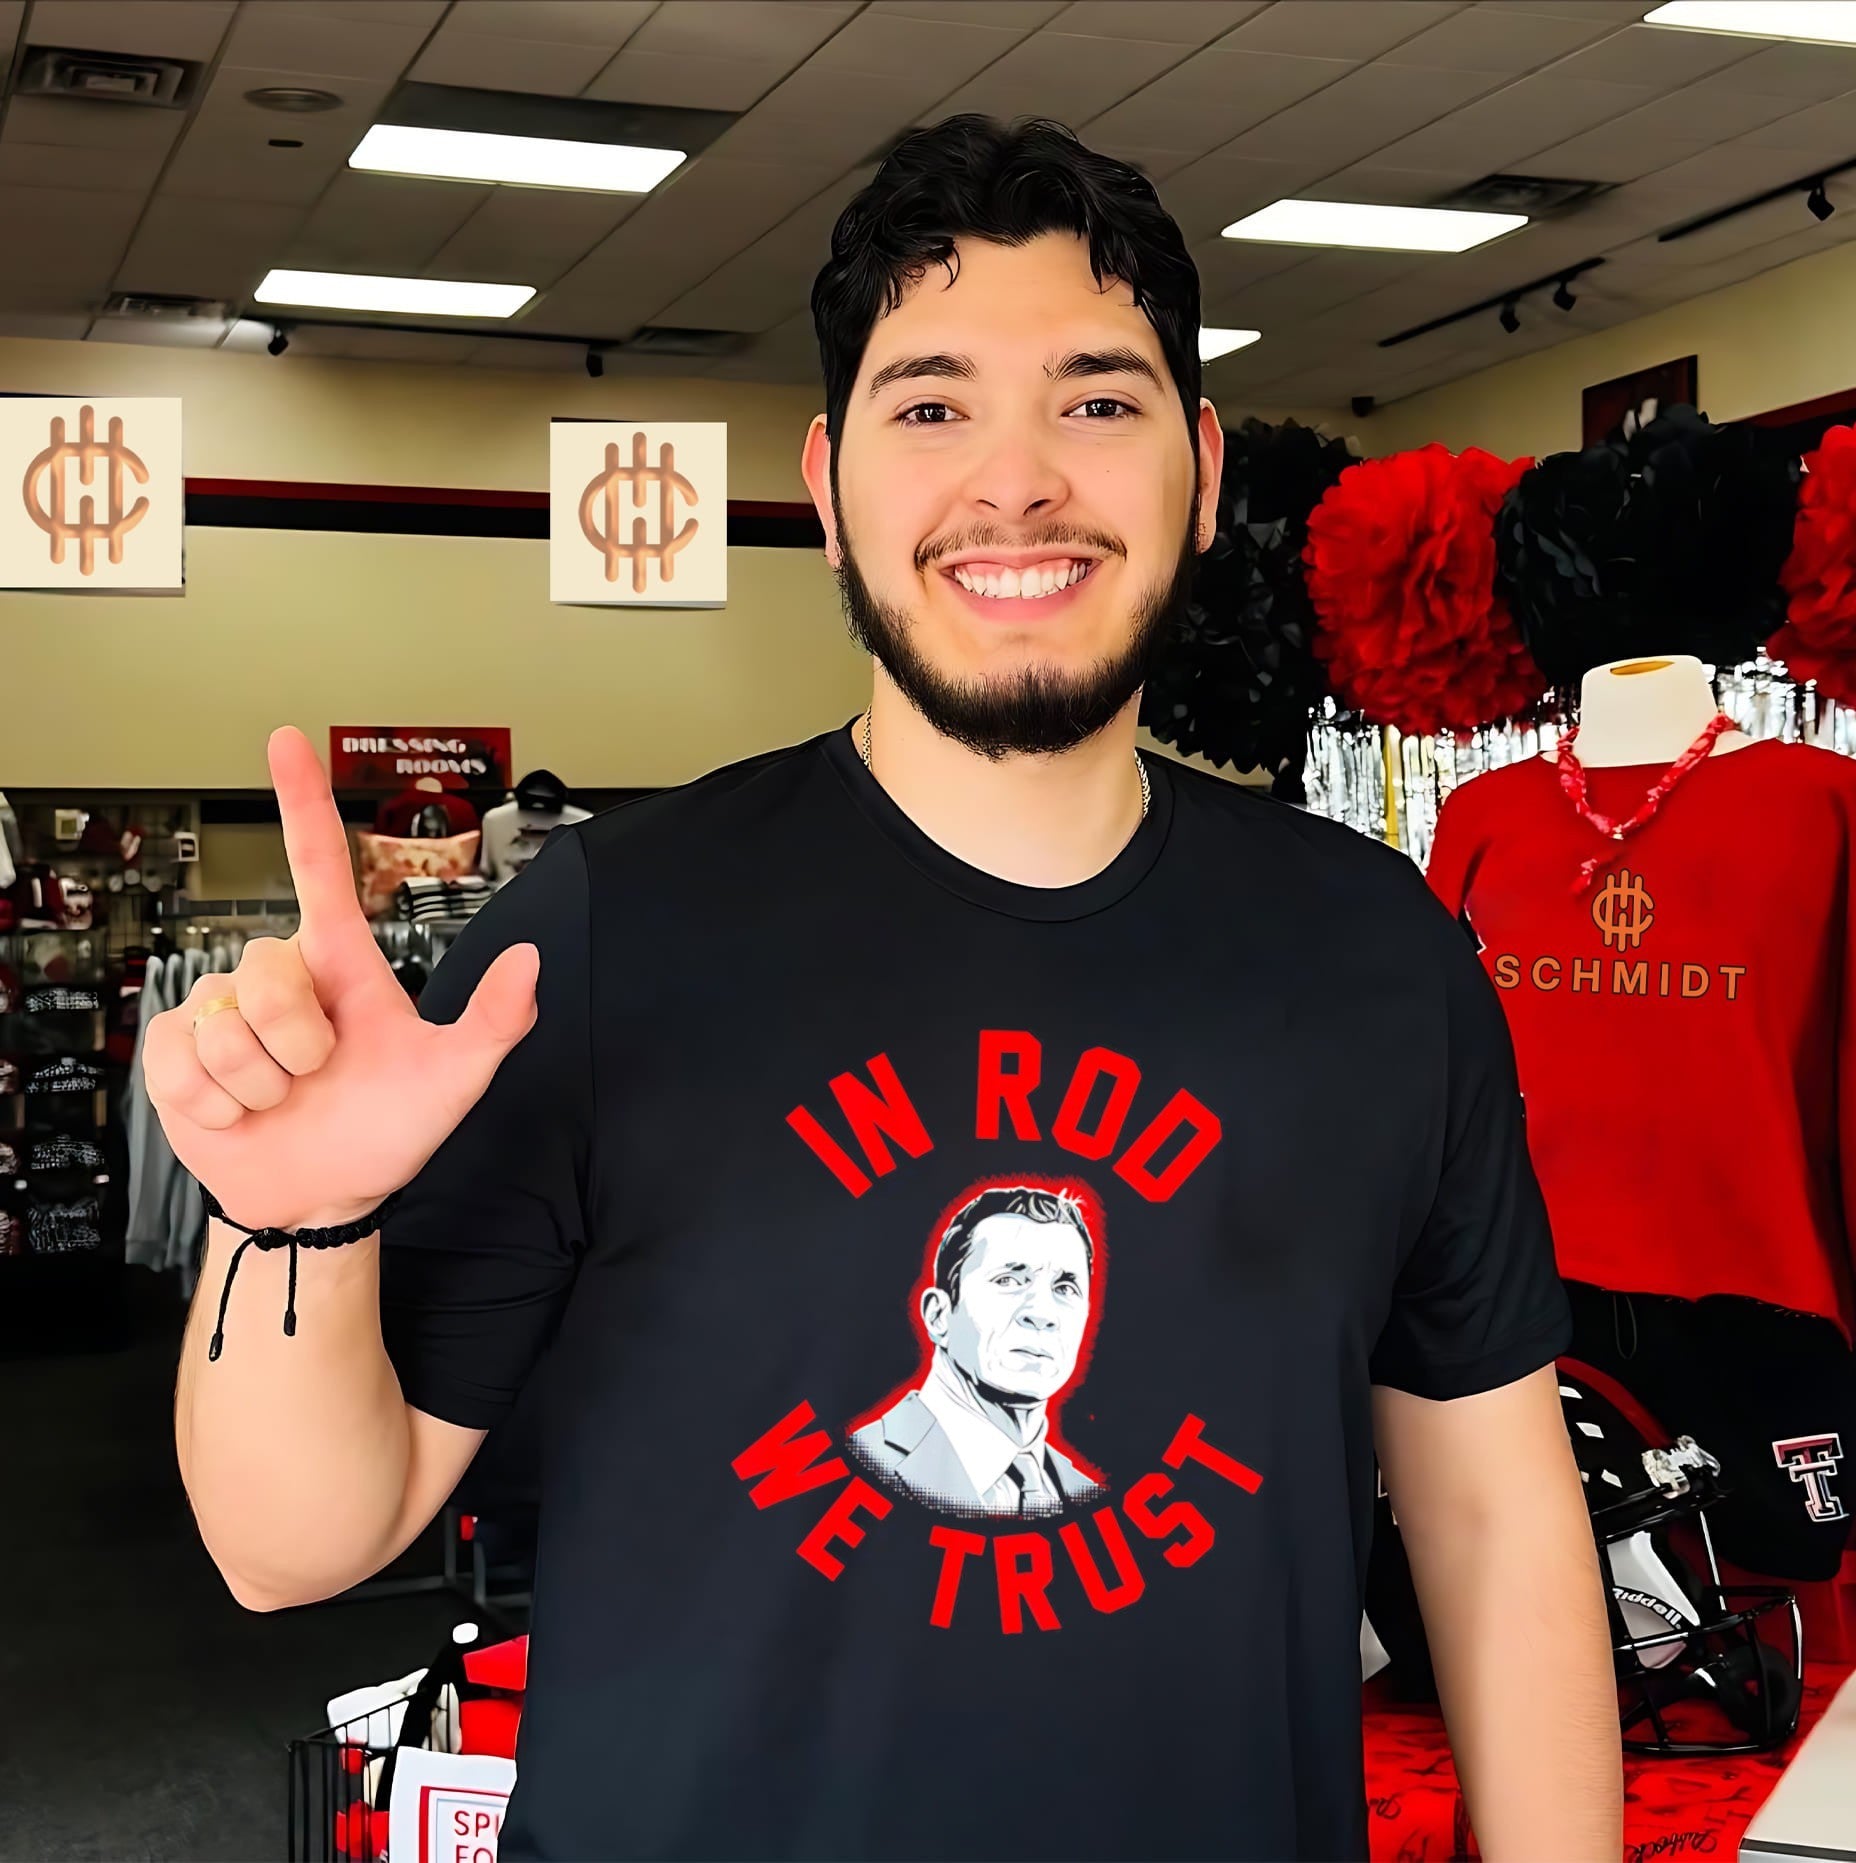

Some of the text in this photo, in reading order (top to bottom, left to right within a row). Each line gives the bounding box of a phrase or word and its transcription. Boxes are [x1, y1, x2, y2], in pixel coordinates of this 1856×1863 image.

[342, 737, 467, 754] DRESSING
[396, 758, 487, 775] ROOMS
[1494, 953, 1748, 1001] SCHMIDT
[785, 1029, 1223, 1203] IN ROD
[731, 1400, 1264, 1636] WE TRUST
